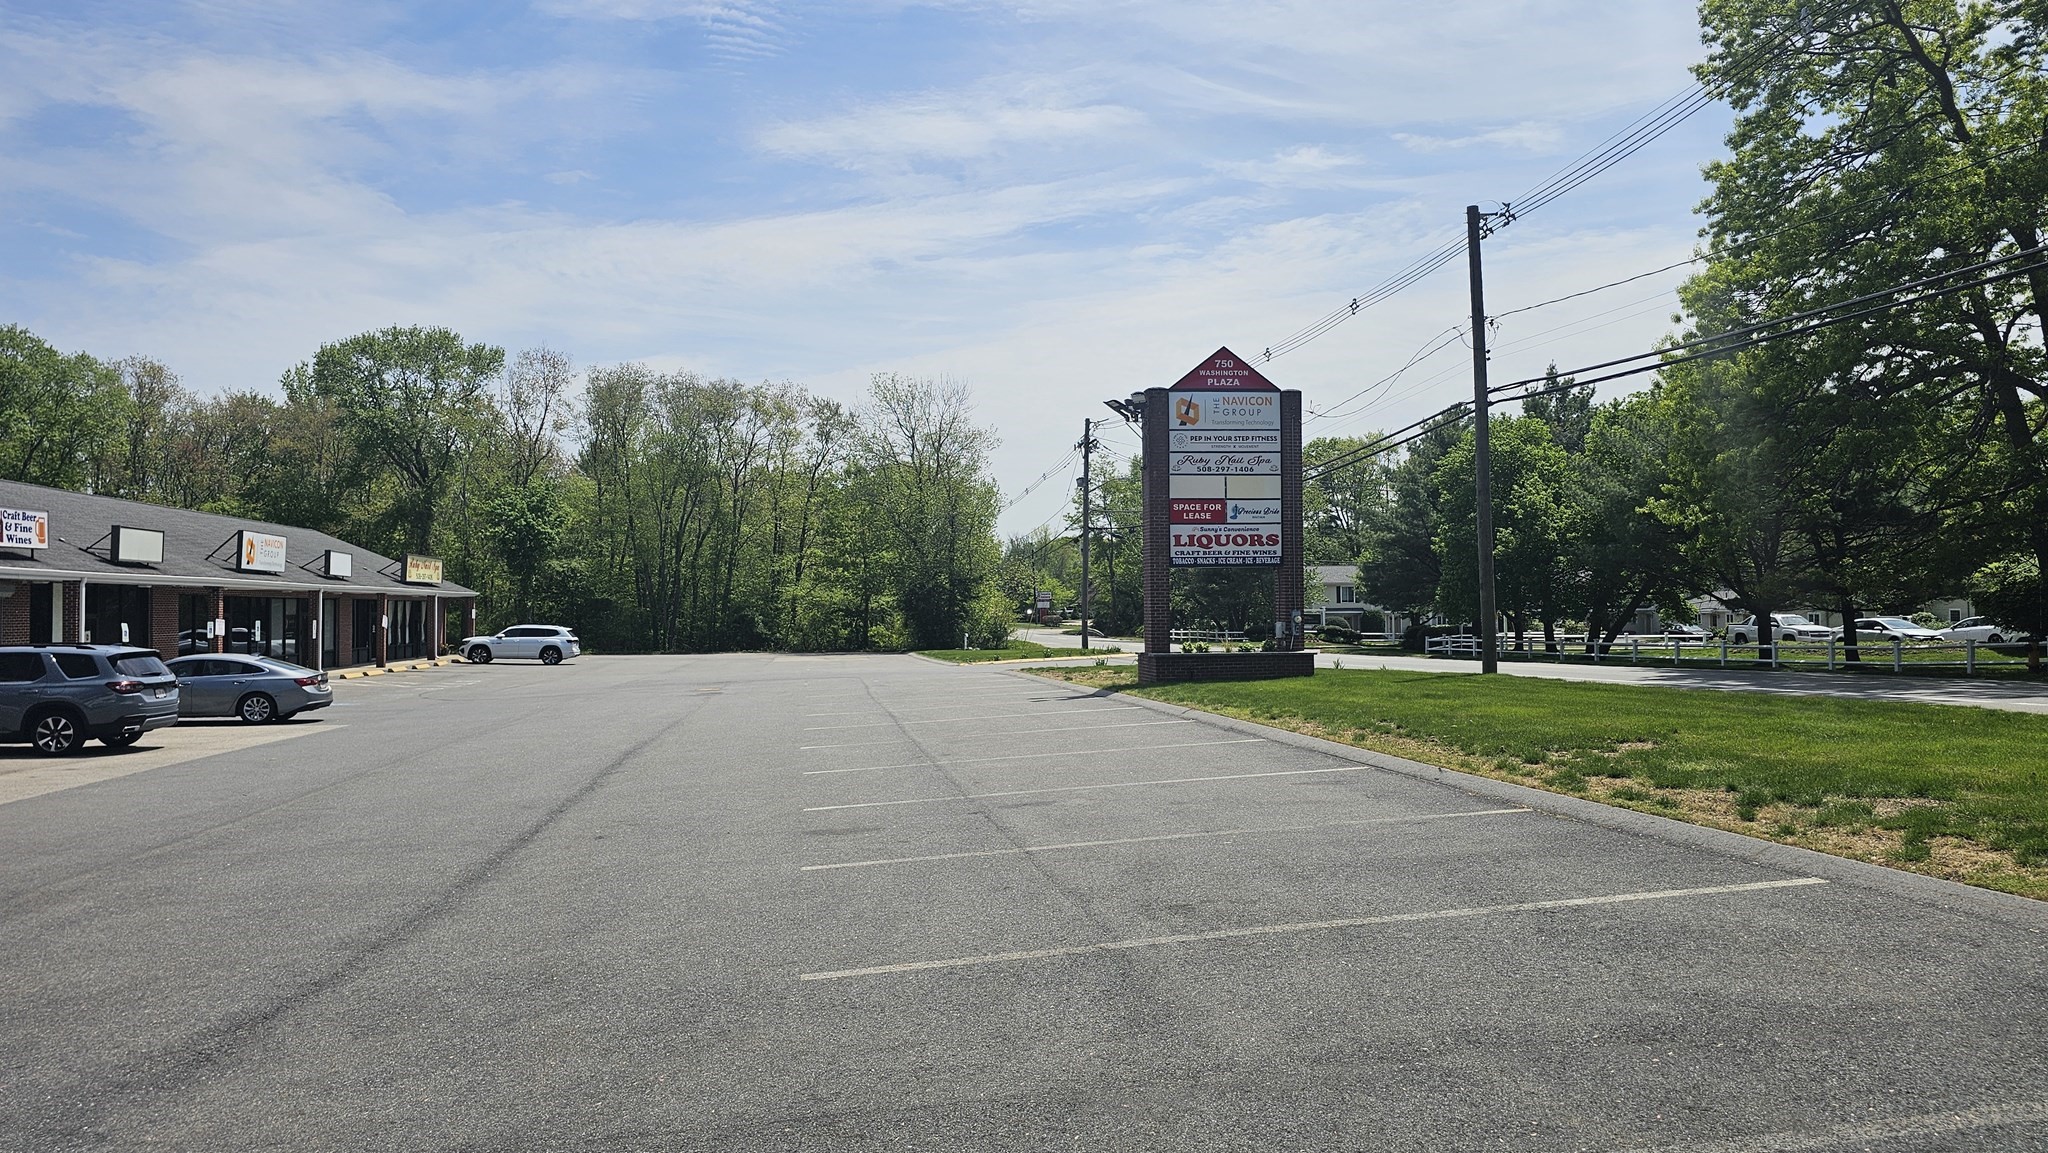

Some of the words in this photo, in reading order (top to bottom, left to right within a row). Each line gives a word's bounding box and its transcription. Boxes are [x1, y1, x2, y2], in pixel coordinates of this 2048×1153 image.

[1223, 397, 1272, 405] NAVICON
[1177, 455, 1210, 465] Ruby
[1215, 455, 1244, 465] Nail
[1248, 455, 1272, 466] Spa
[3, 510, 20, 520] Craft
[22, 512, 36, 521] Beer
[5, 522, 12, 531] &
[15, 523, 32, 533] Fine
[7, 534, 31, 544] Wines
[264, 539, 283, 549] NAVICON
[1173, 534, 1279, 549] LIQUORS
[264, 550, 279, 558] GROUP
